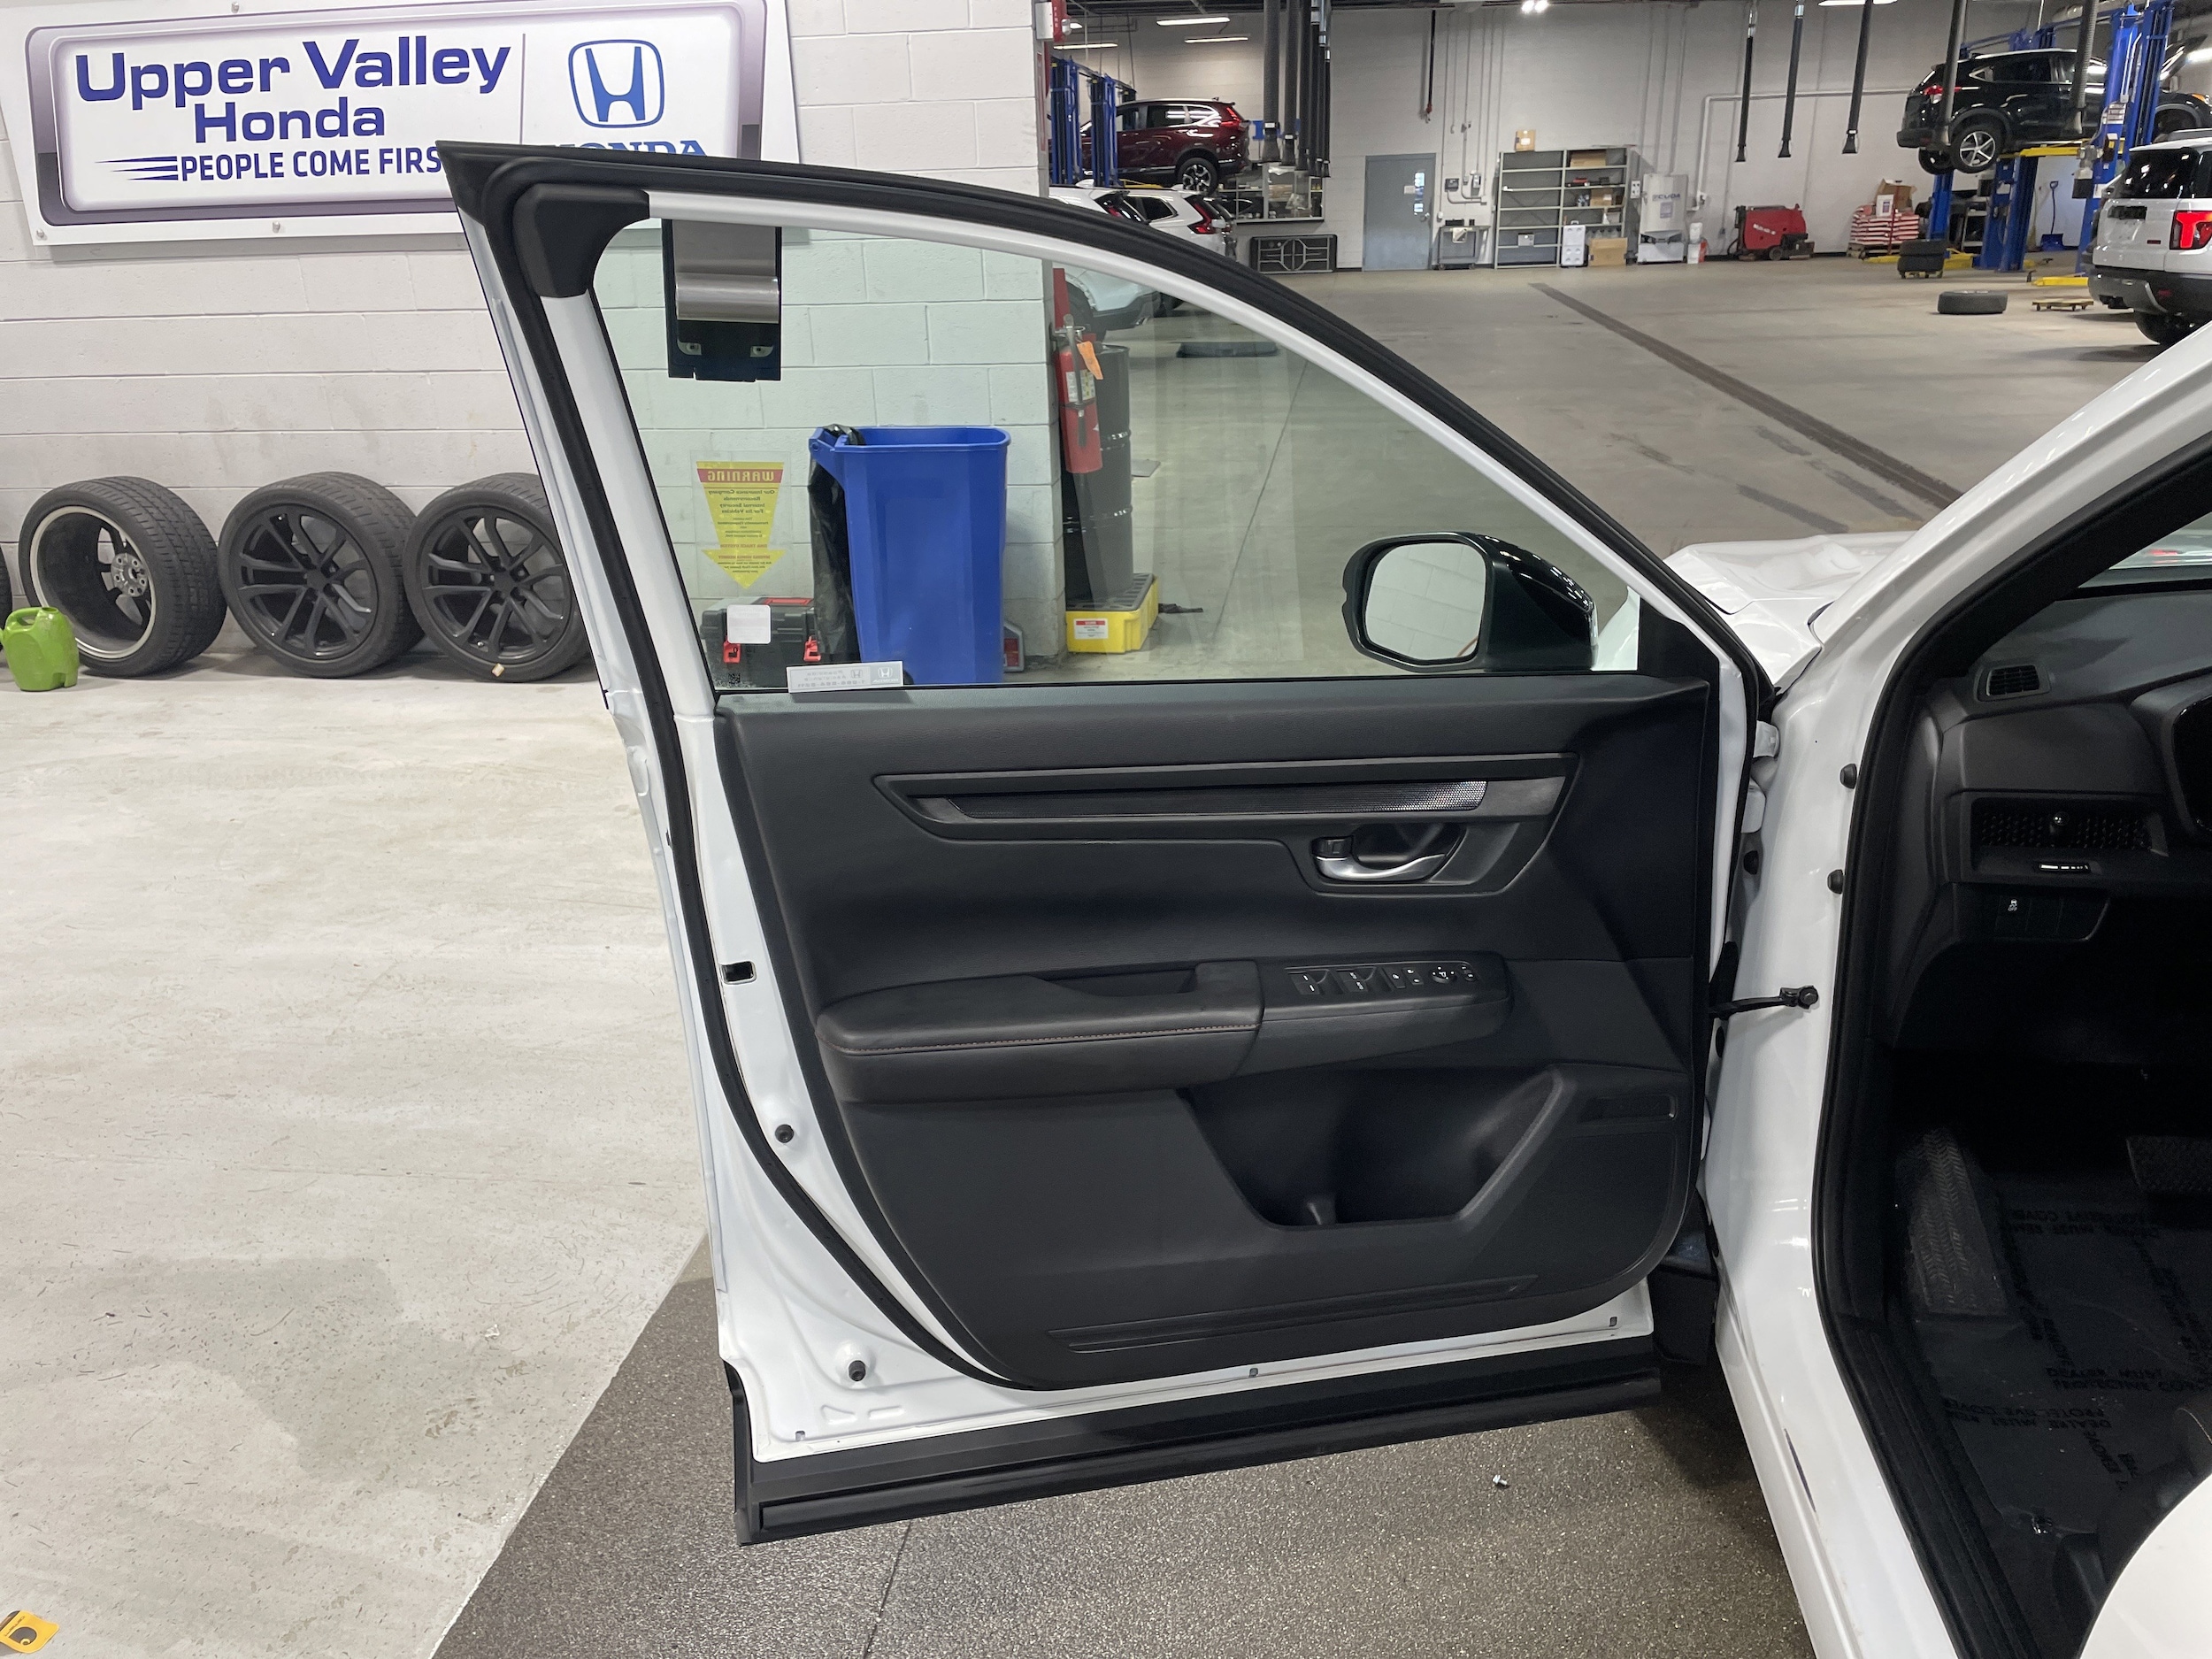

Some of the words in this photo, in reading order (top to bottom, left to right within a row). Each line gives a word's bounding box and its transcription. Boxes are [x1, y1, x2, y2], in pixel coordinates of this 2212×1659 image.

[76, 53, 290, 110] Upper
[303, 35, 511, 94] Valley
[195, 96, 385, 143] Honda
[181, 152, 284, 181] PEOPLE
[293, 149, 370, 177] COME
[379, 147, 442, 174] FIRS
